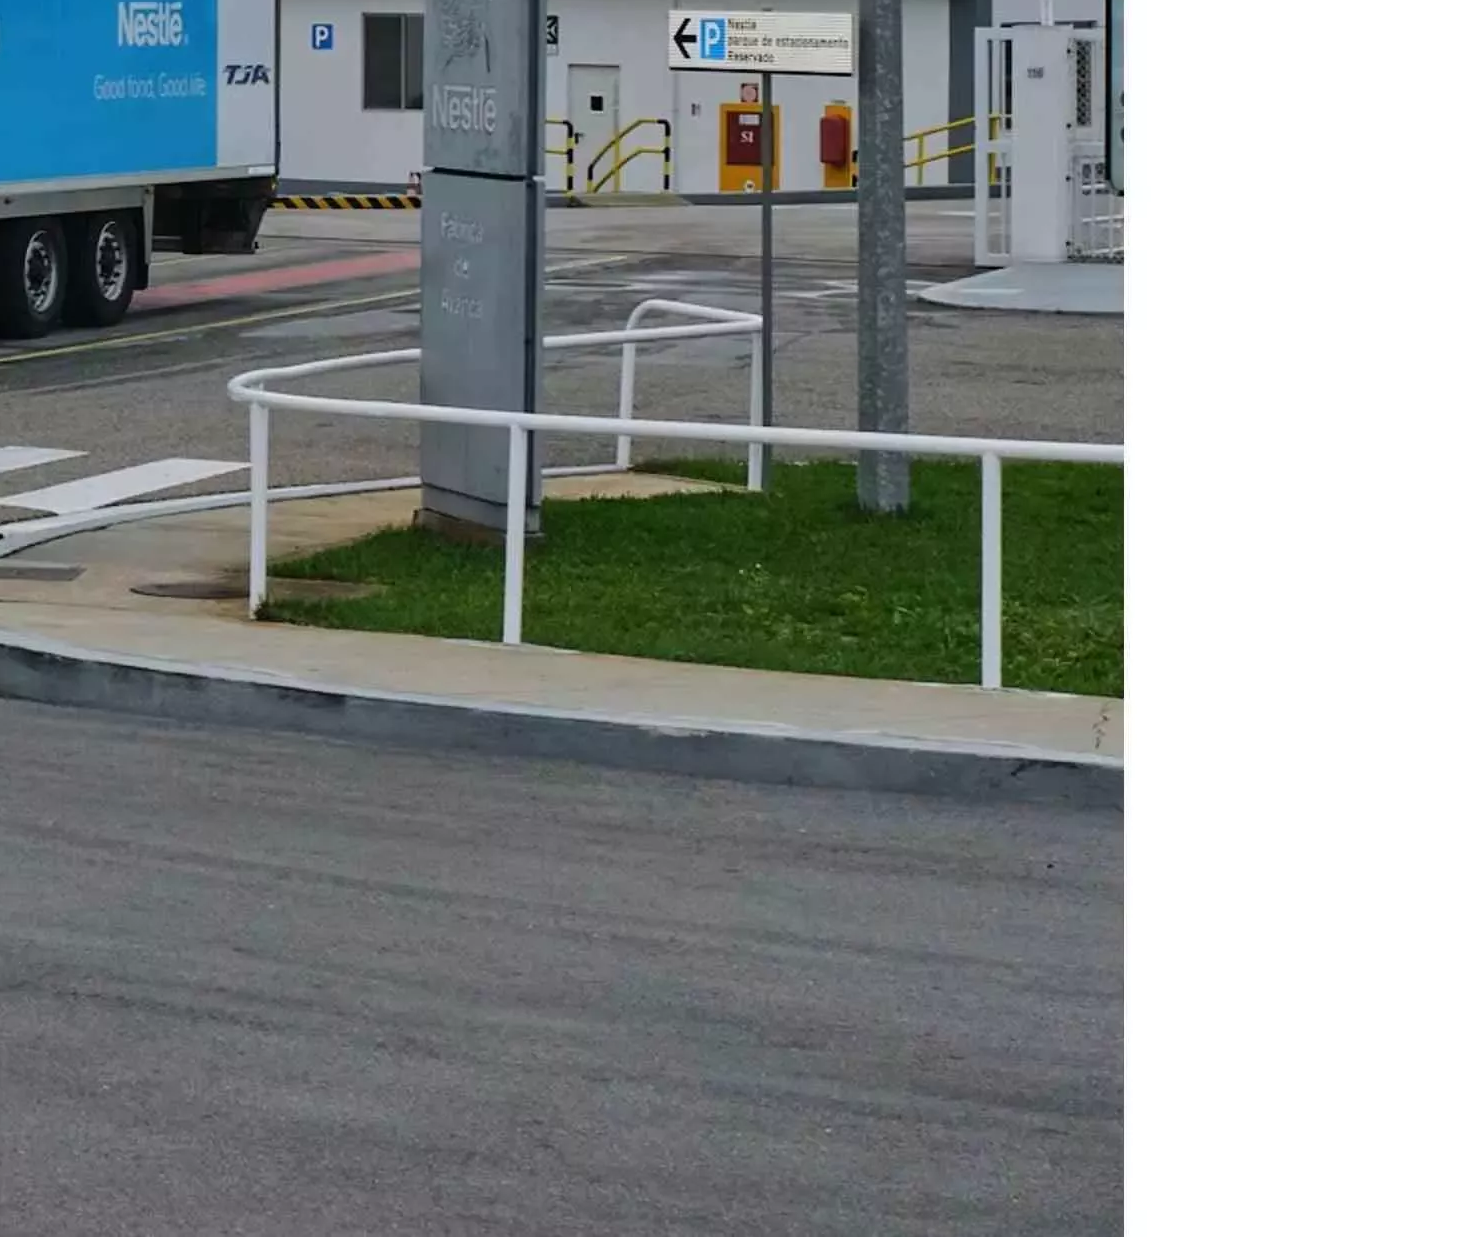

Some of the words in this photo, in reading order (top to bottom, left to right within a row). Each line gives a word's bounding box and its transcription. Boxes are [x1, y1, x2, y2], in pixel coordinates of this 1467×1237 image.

[118, 1, 183, 47] Nestlé
[315, 25, 329, 49] P
[704, 20, 721, 57] P
[93, 73, 126, 100] Good
[223, 63, 272, 86] TJA
[432, 83, 498, 132] Nestlé
